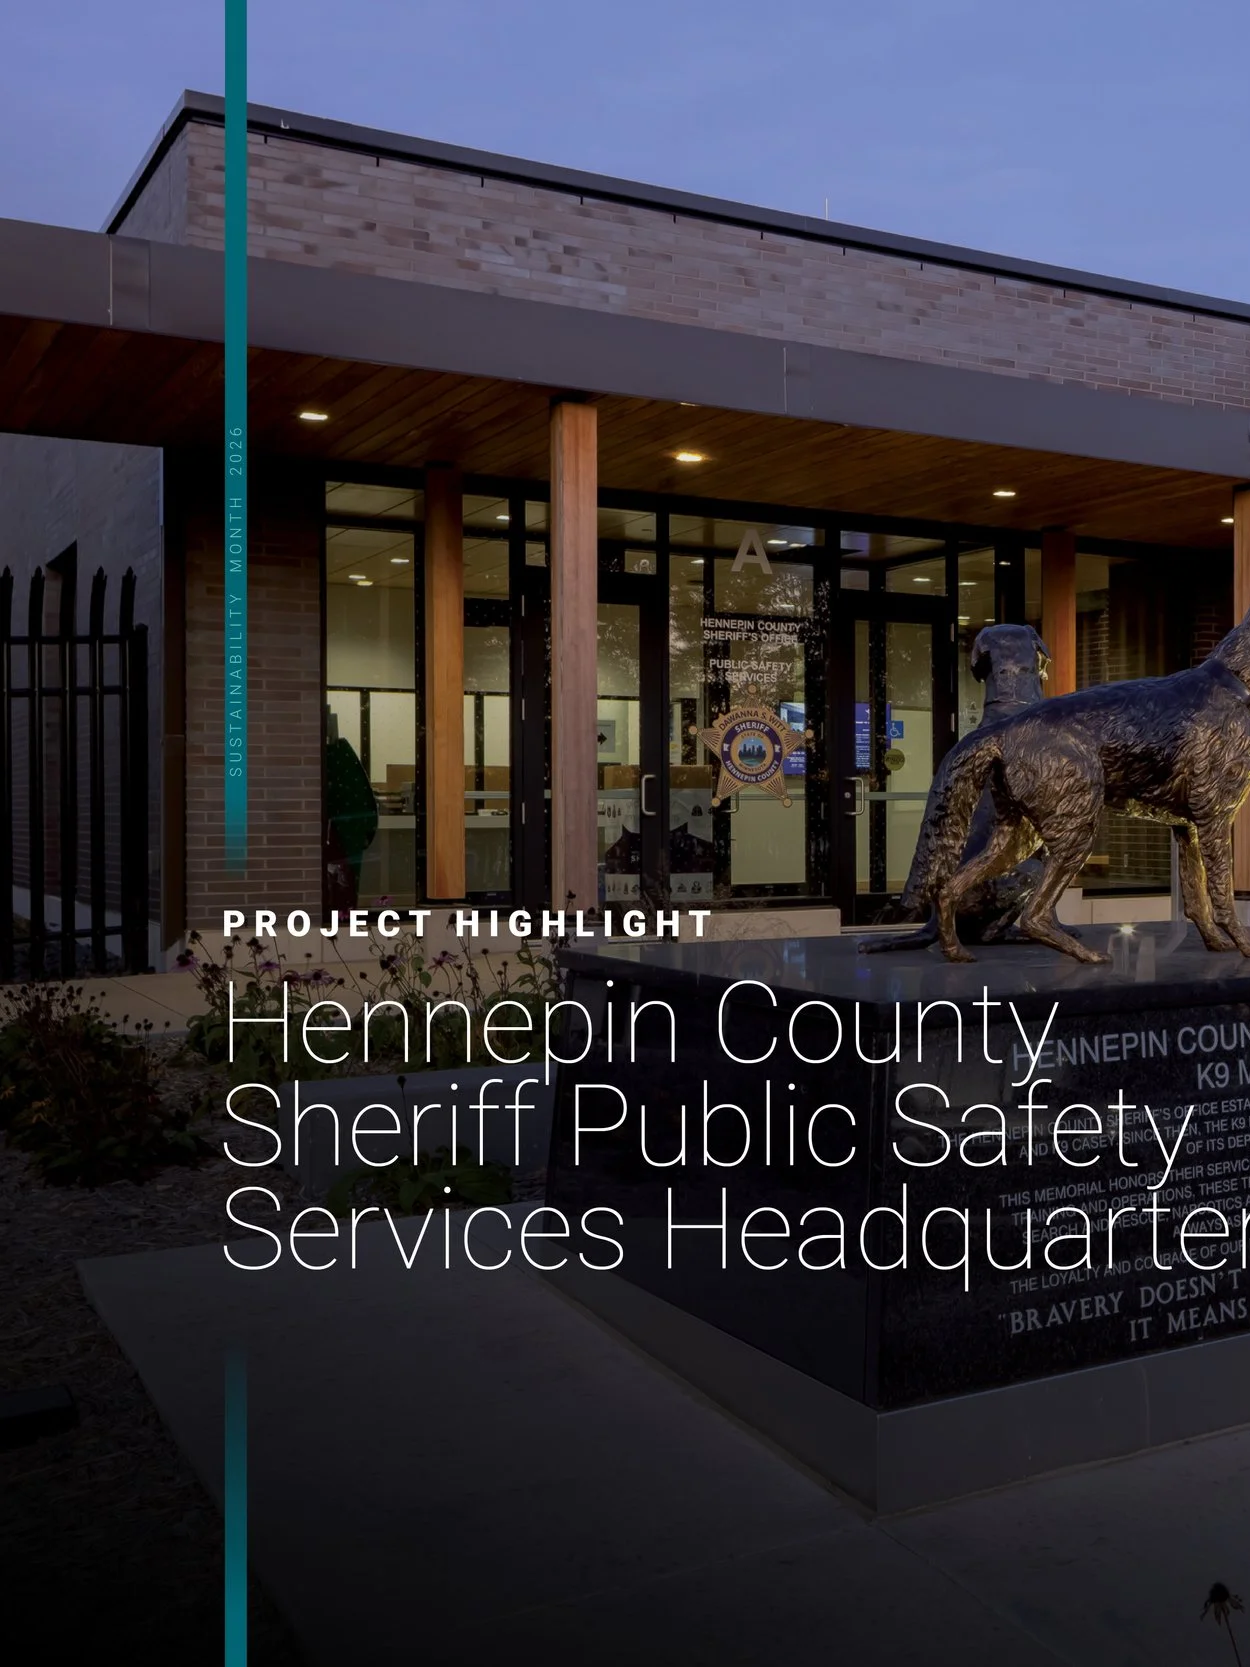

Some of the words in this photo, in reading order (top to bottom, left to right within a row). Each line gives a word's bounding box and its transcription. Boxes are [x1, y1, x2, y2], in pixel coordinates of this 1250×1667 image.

[731, 529, 773, 575] A
[700, 618, 755, 630] HENNEPIN
[757, 621, 801, 632] COUNTY
[703, 630, 758, 642] SHERIFF'S
[761, 633, 798, 644] OFFICE
[709, 659, 749, 670] PUBLIC
[751, 661, 793, 672] SAFETY
[724, 671, 778, 683] SERVICES
[718, 710, 759, 731] DAWANNA
[734, 721, 771, 733] SHERIFF
[725, 760, 757, 782] HENNEPIN
[757, 760, 779, 782] COUNTY
[1012, 1029, 1168, 1072] HENNEPIN
[1196, 1062, 1230, 1090] K9
[971, 1124, 1043, 1145] HENNEPN
[1048, 1114, 1103, 1134] COUNT
[1174, 1102, 1218, 1119] OFFICE
[1019, 1143, 1048, 1158] AND
[1204, 1119, 1228, 1133] THE
[1231, 1117, 1245, 1130] K9
[1186, 1141, 1202, 1154] OF
[1206, 1138, 1225, 1153] ITS
[1000, 1191, 1031, 1208] THIS
[1034, 1180, 1106, 1201] MEMORIAL
[1109, 1171, 1164, 1192] HONORS
[1168, 1166, 1204, 1182] THEIR
[1081, 1199, 1107, 1216] AND
[1198, 1179, 1238, 1195] THESE
[1172, 1218, 1223, 1238] AWAYS
[1227, 1215, 1241, 1228] AS
[1010, 1277, 1038, 1295] THE
[1042, 1266, 1100, 1288] LOYALTY
[1103, 1260, 1131, 1277] AND
[1200, 1244, 1217, 1259] OF
[1140, 1268, 1241, 1309] DOESN'T
[1129, 1316, 1152, 1342] IT
[1167, 1297, 1247, 1334] MEANS
